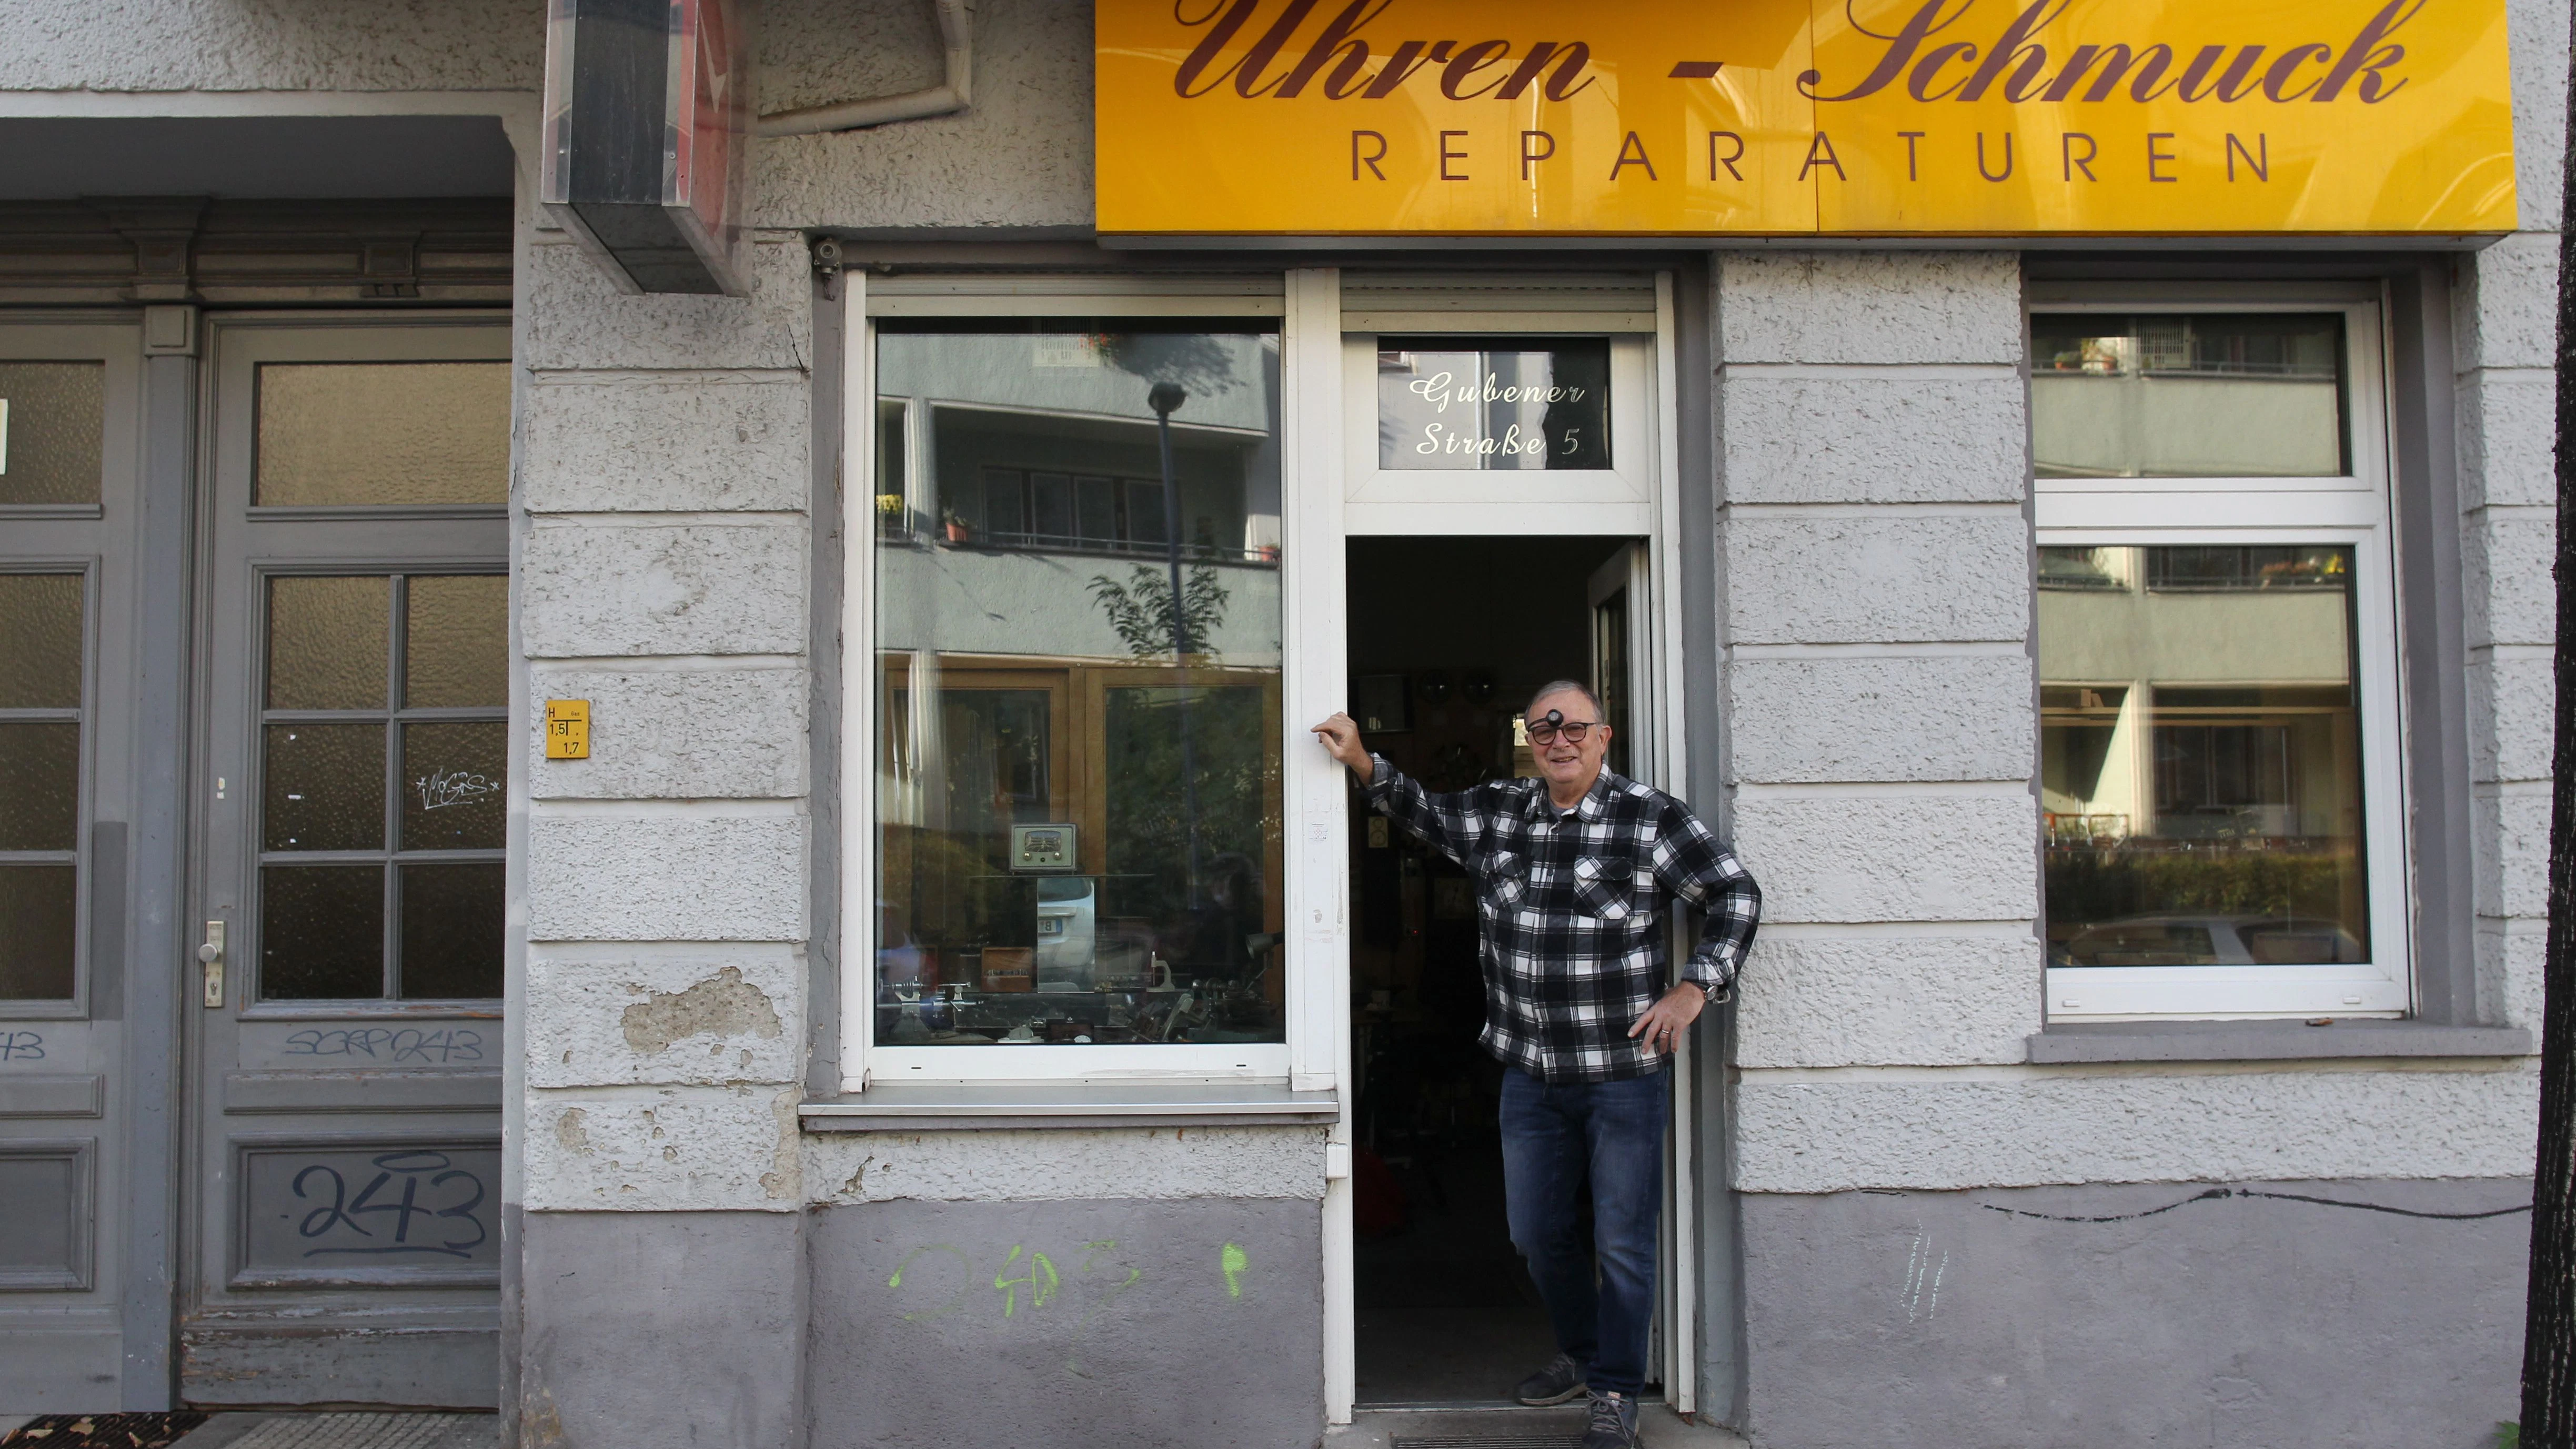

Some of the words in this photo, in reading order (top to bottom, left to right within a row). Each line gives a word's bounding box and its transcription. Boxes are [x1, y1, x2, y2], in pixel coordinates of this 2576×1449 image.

[1174, 0, 1595, 102] Uhren
[1796, 0, 2423, 104] Schmuck
[1352, 130, 2268, 183] REPARATUREN
[1409, 371, 1585, 414] Gubener
[1416, 422, 1547, 457] Straße
[1561, 428, 1580, 455] 5
[548, 707, 555, 718] H
[564, 742, 579, 756] 1,7
[293, 1165, 486, 1250] 243
